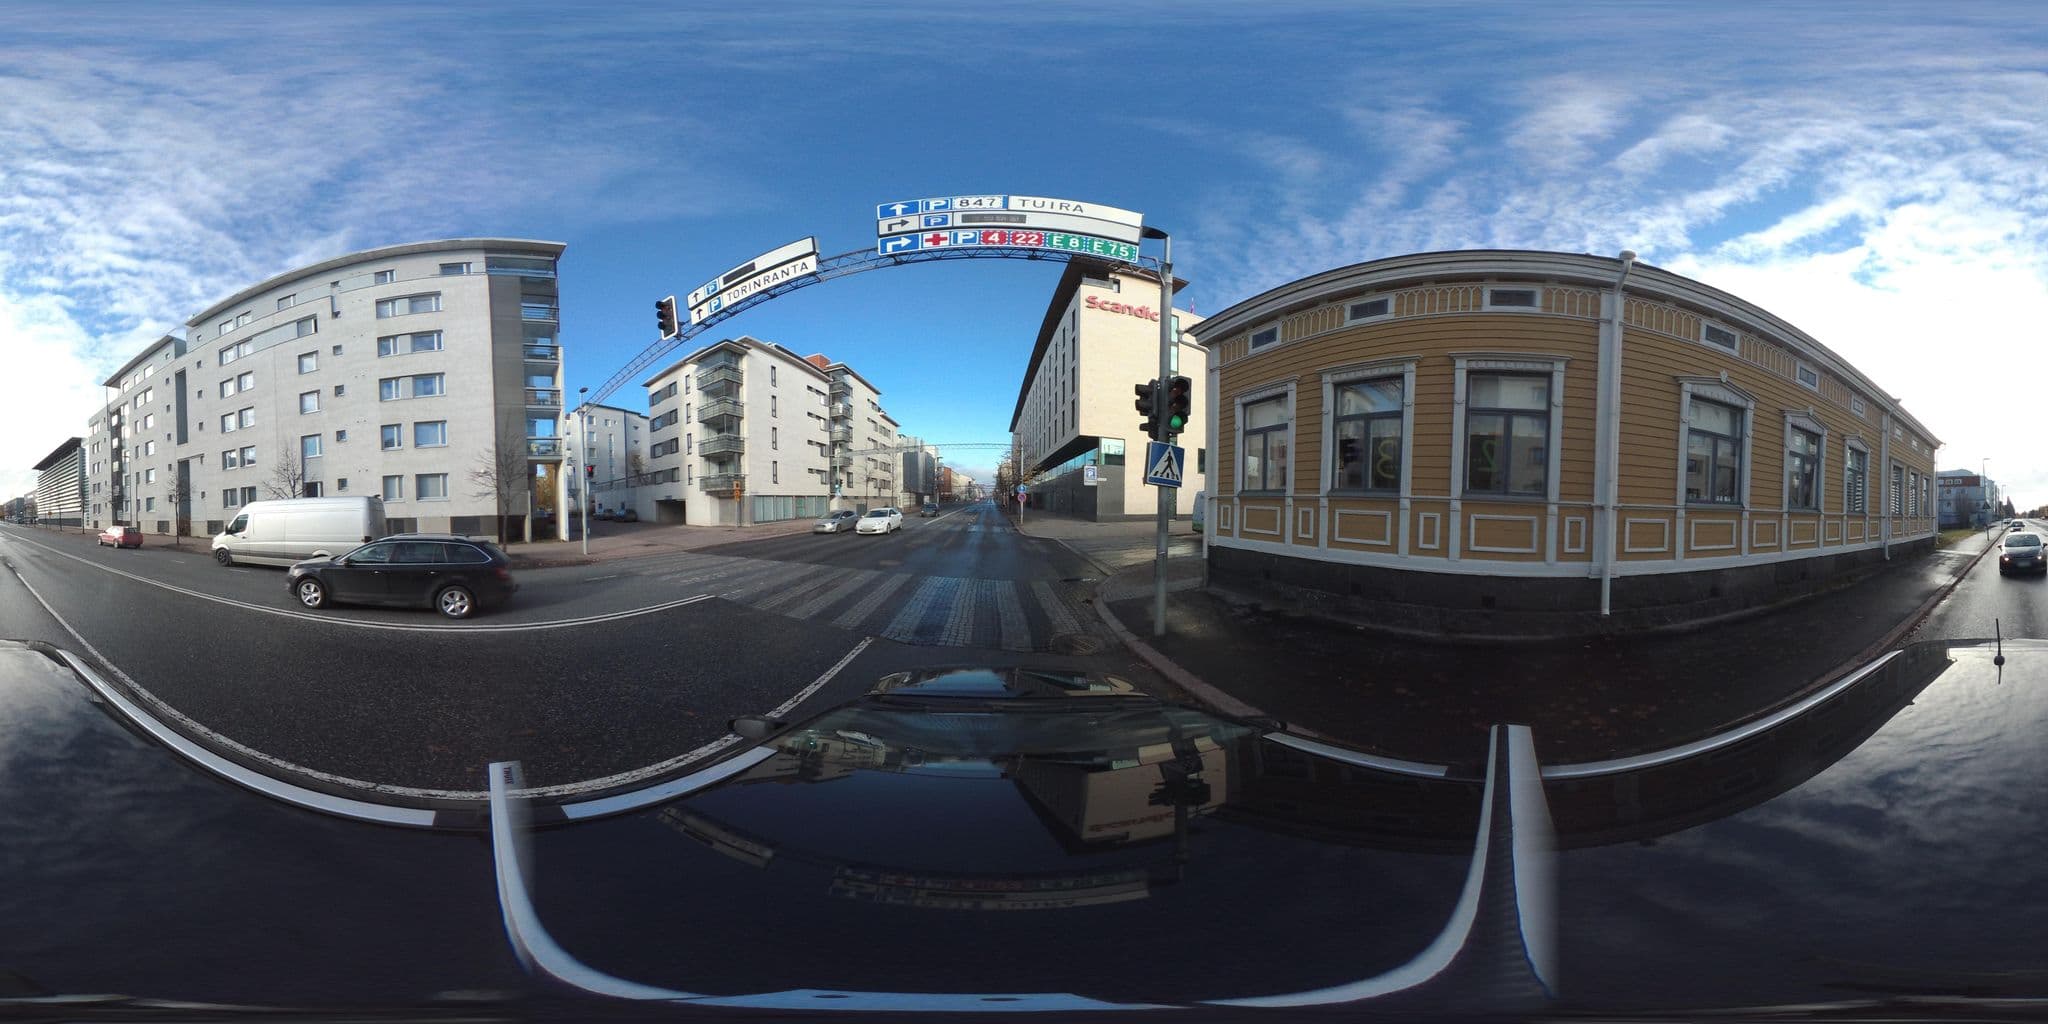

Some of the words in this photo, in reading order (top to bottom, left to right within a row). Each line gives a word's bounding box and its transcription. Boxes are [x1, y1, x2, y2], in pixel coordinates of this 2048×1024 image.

[929, 200, 946, 211] P
[959, 198, 996, 207] 847
[1018, 199, 1084, 213] TUIRA
[930, 217, 943, 226] P
[957, 232, 976, 244] P
[988, 232, 1000, 242] 4
[1016, 233, 1039, 244] 22
[710, 299, 721, 312] P
[727, 262, 809, 302] TORINRANTA
[1085, 295, 1160, 322] Scandic
